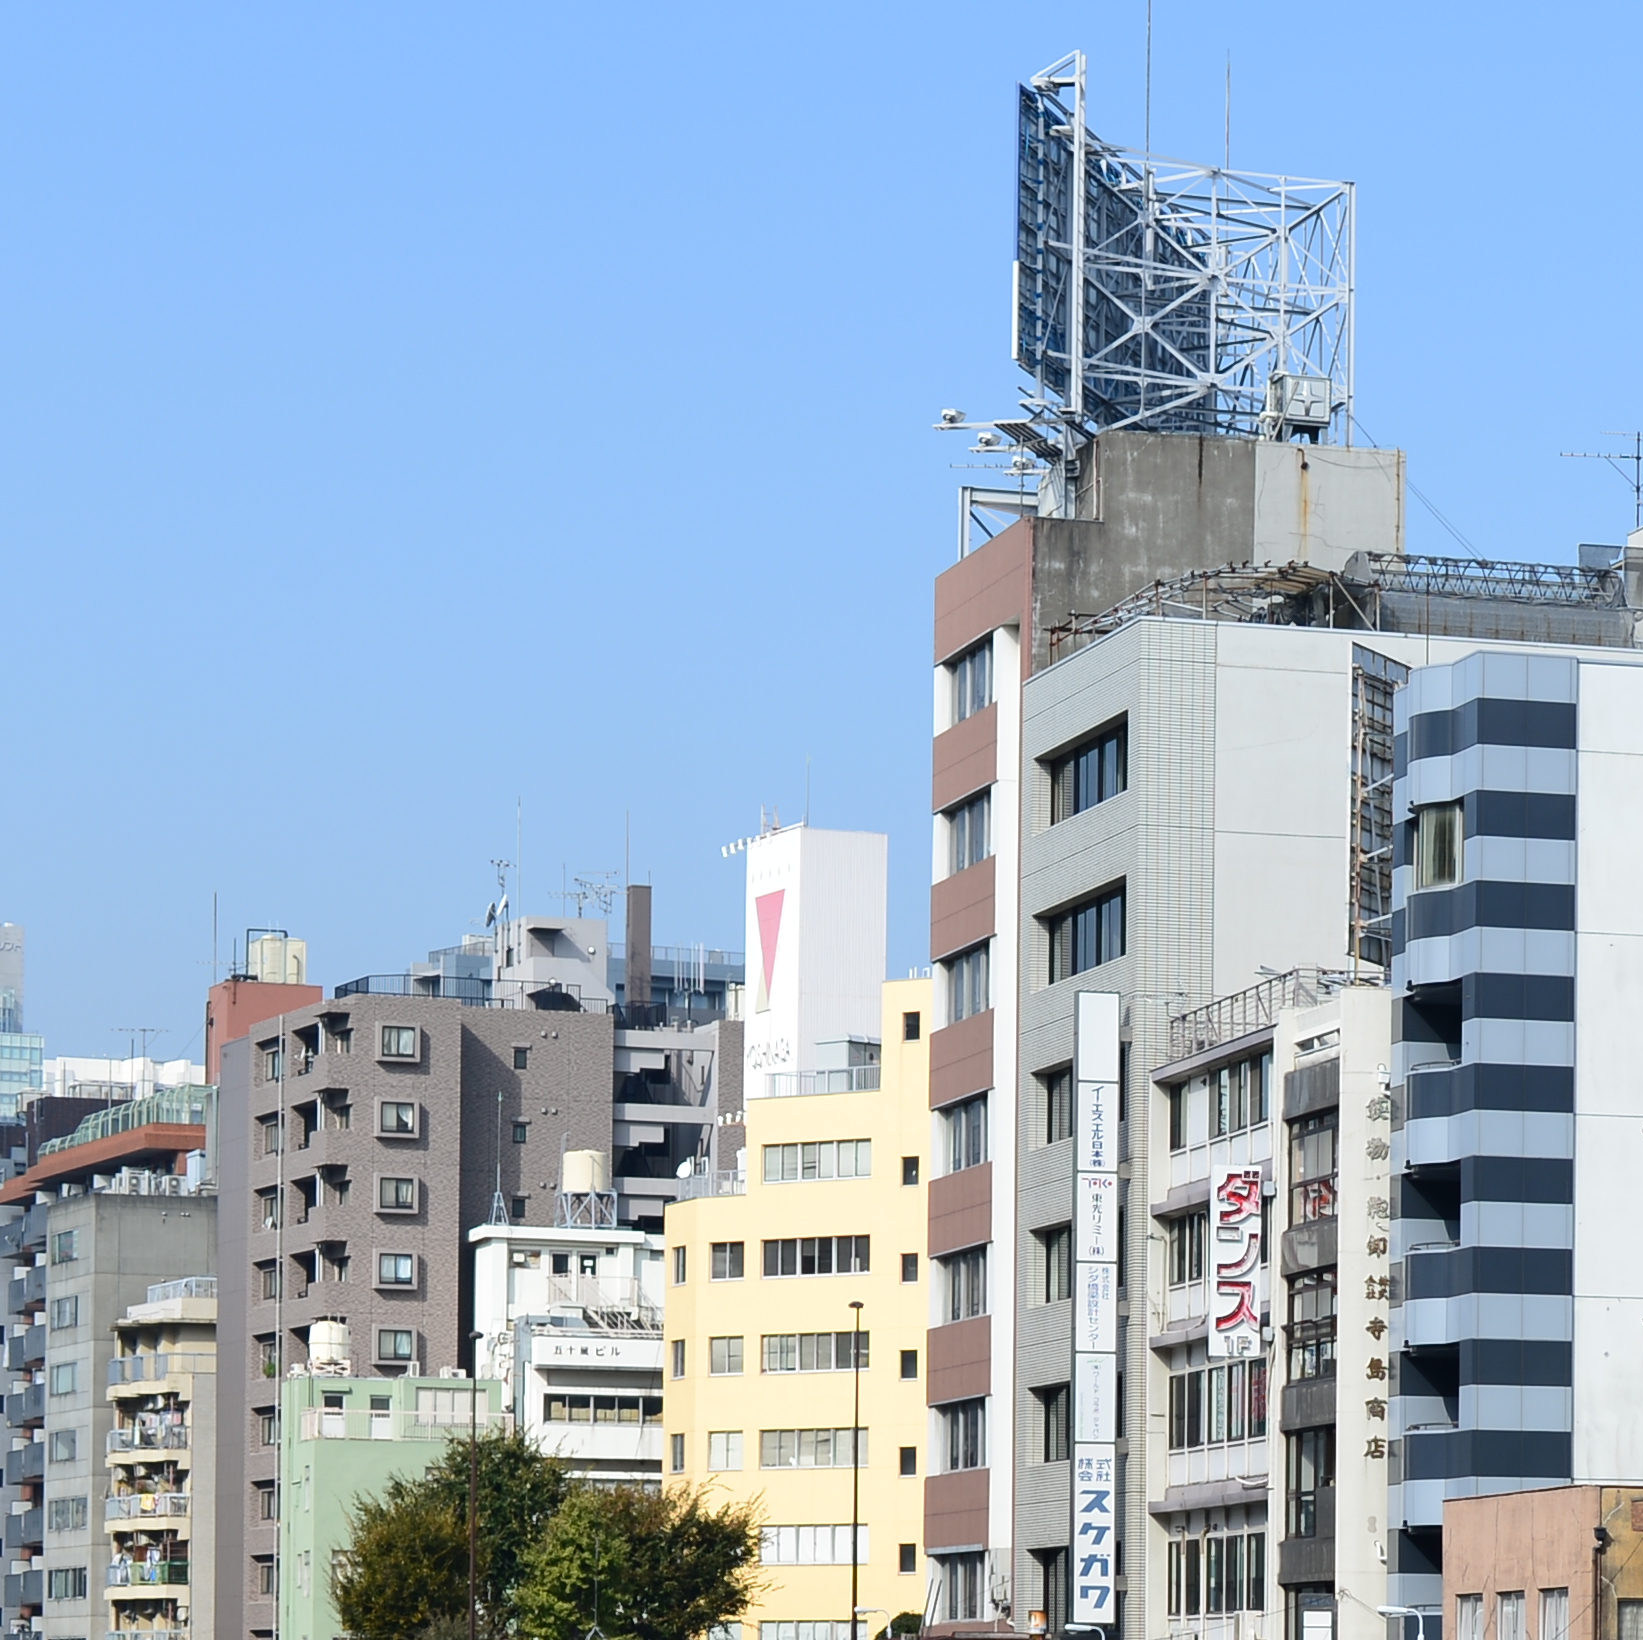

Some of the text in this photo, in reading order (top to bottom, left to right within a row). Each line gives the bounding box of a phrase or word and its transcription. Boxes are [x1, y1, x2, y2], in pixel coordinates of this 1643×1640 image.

[1216, 1170, 1261, 1332] ダンス
[1364, 1316, 1388, 1460] 寺島商店
[1078, 1489, 1111, 1609] スケガワ
